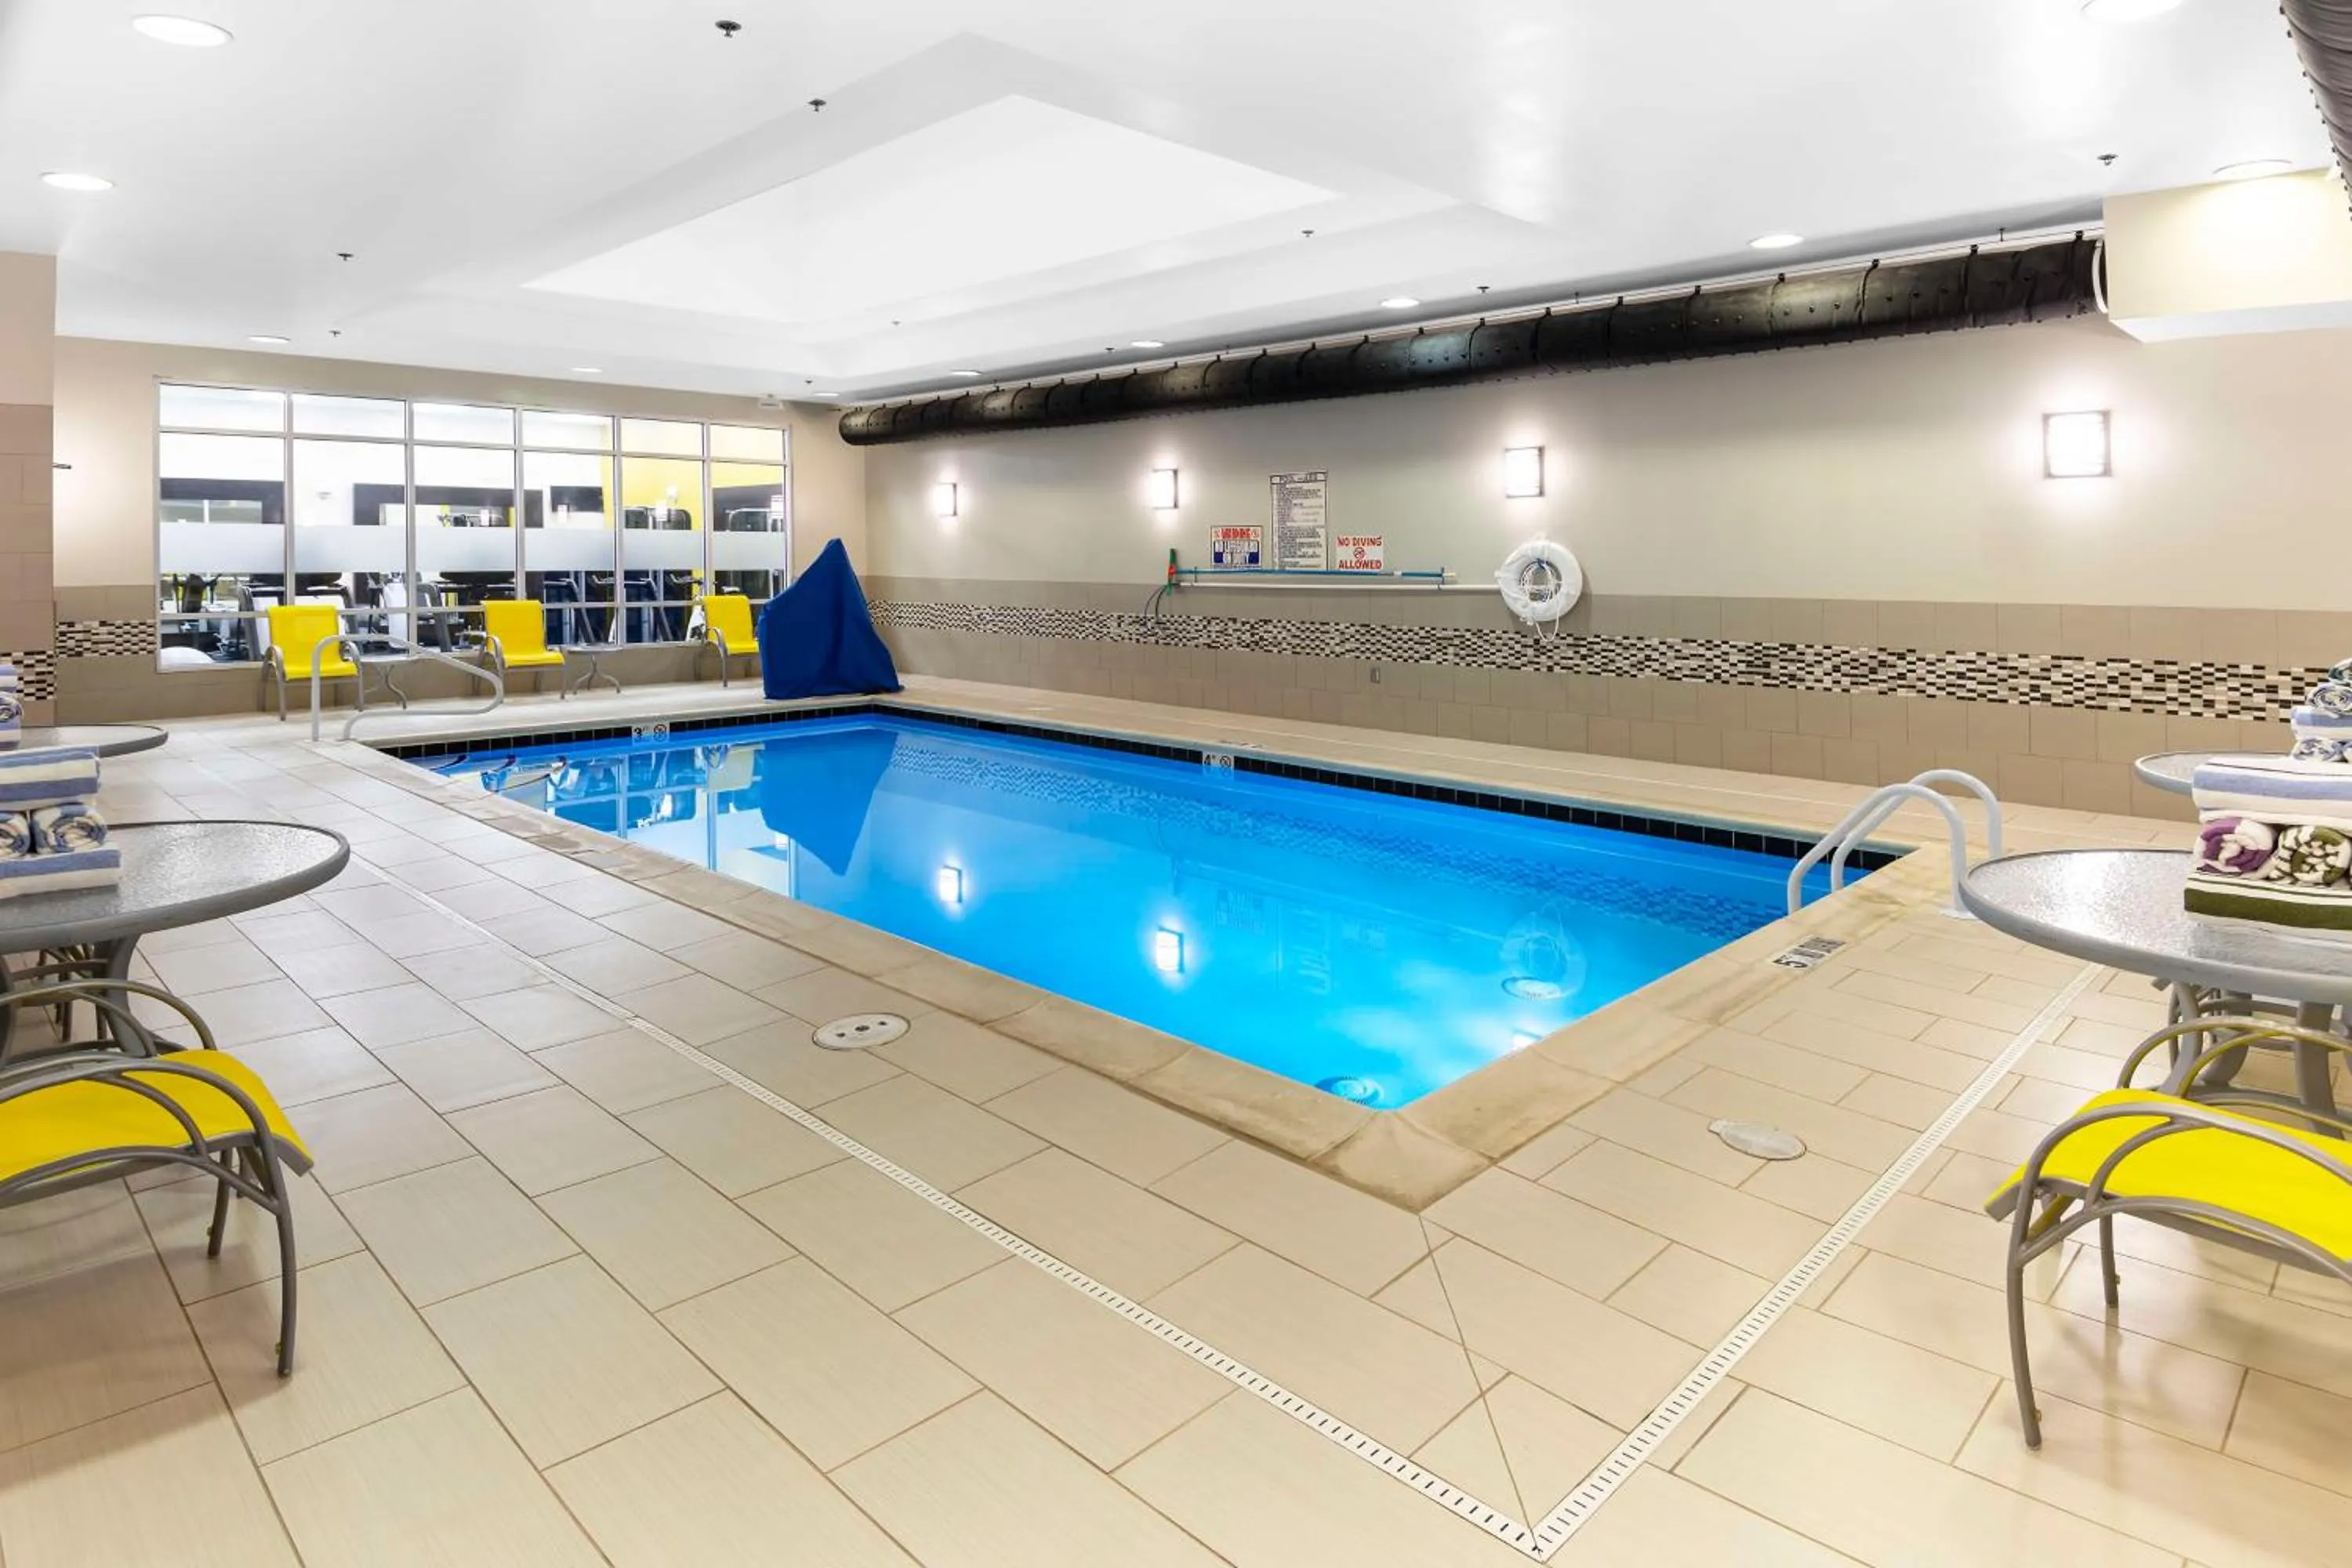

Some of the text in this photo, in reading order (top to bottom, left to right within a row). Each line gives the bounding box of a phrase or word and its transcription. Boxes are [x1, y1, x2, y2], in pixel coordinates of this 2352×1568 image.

[1338, 536, 1382, 546] NO DIVING
[1338, 560, 1382, 570] ALLOWED
